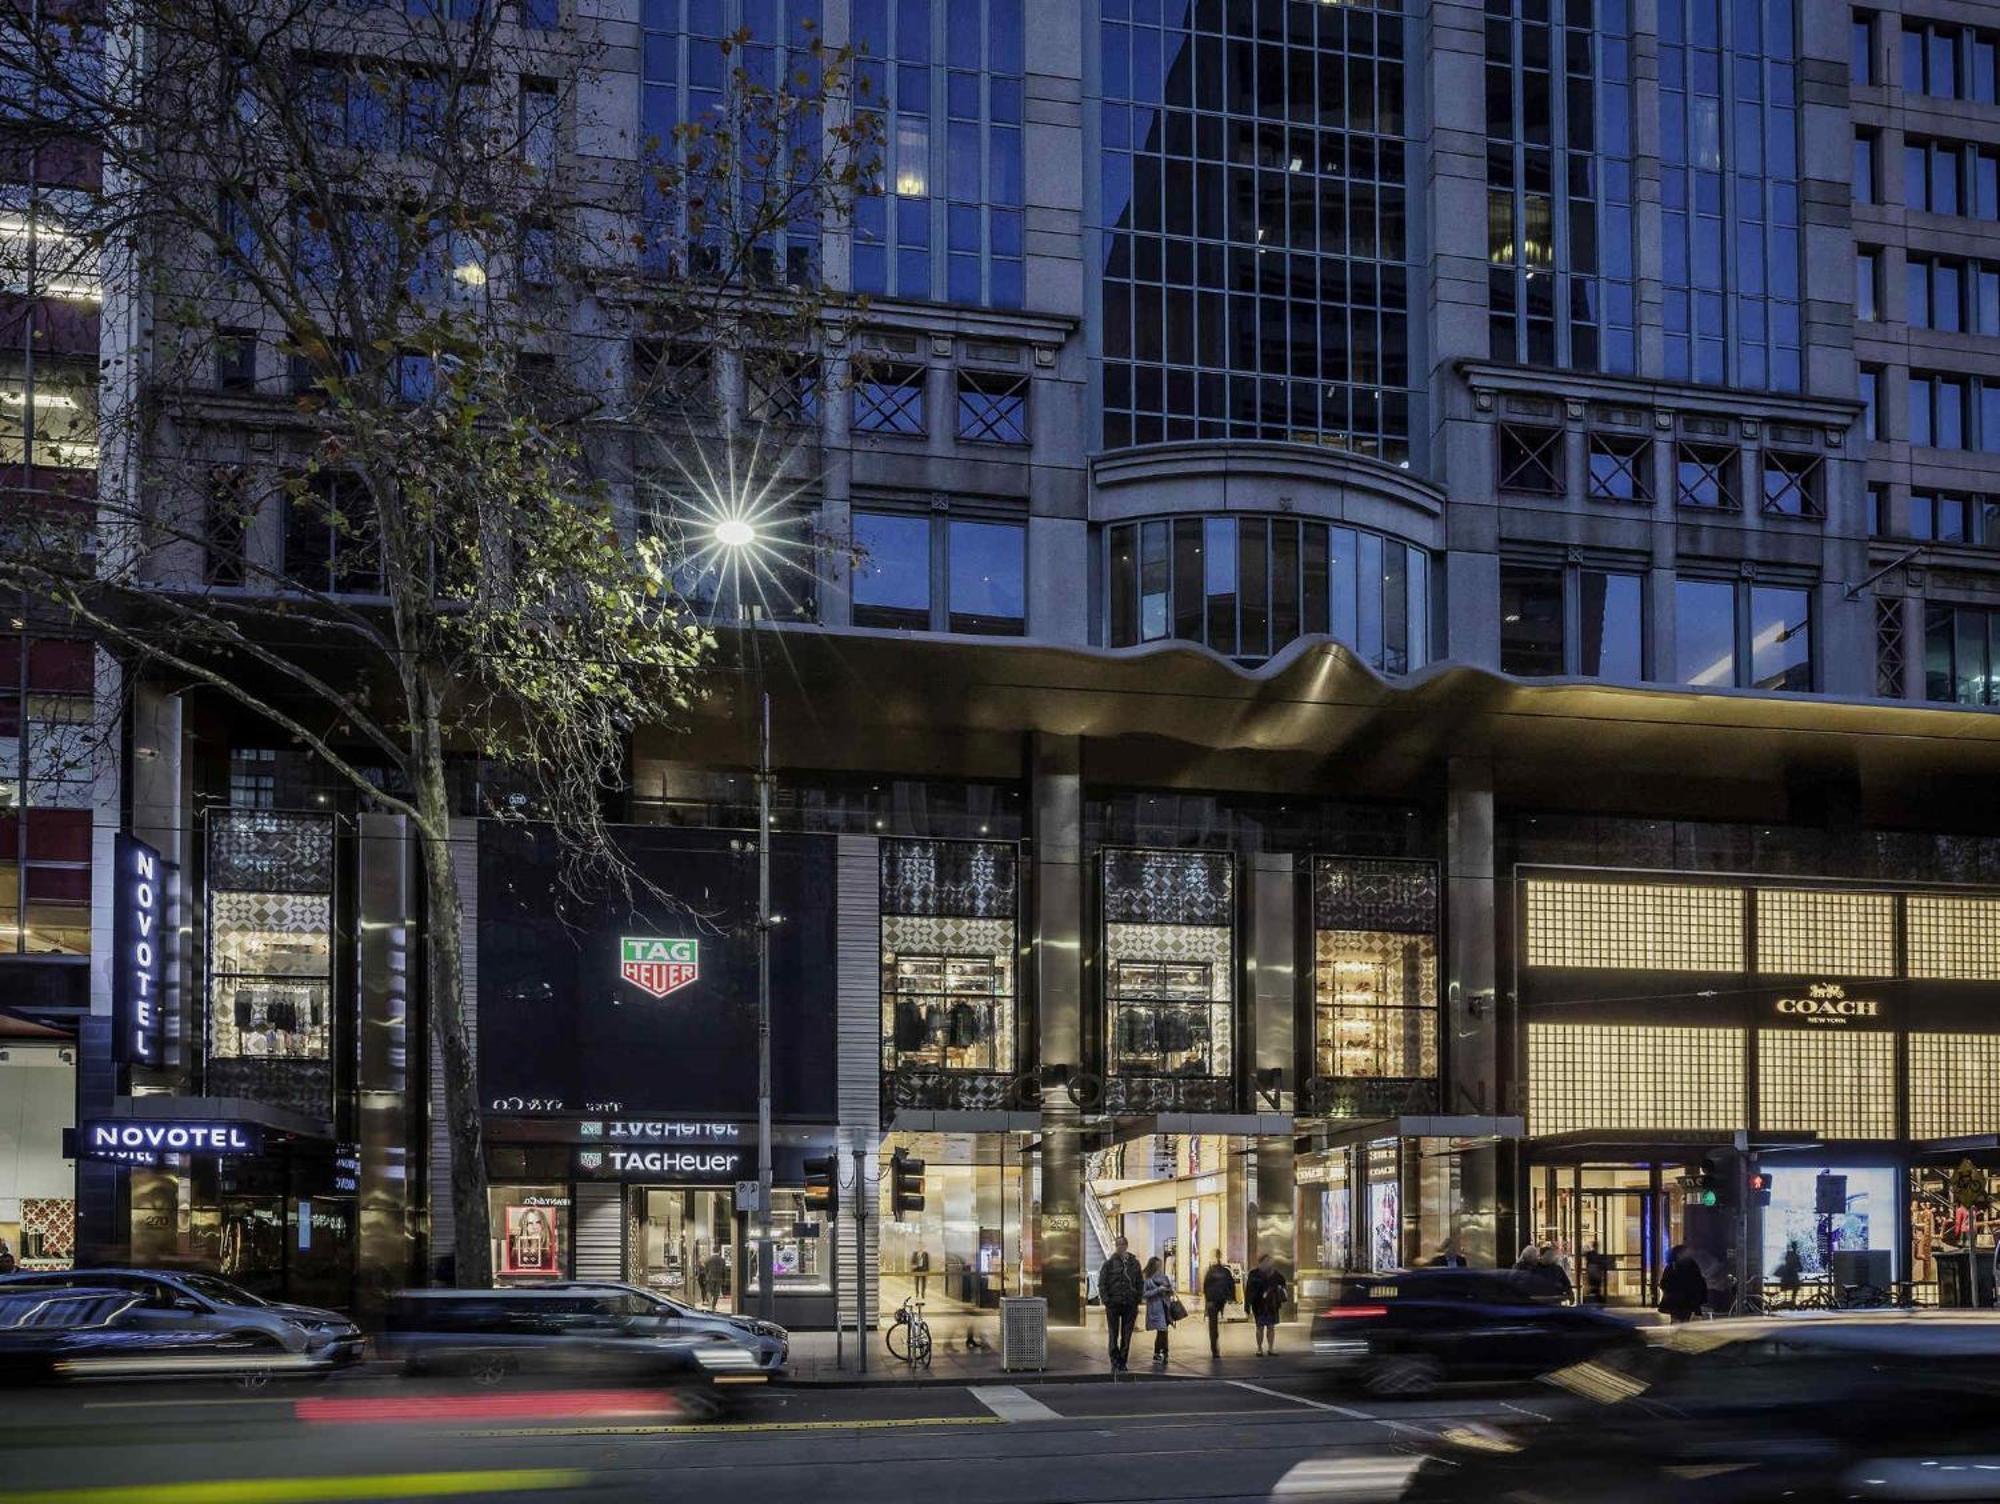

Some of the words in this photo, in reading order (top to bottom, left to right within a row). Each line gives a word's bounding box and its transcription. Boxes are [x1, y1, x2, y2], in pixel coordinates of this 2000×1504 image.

[137, 851, 153, 1055] NOVOTEL
[628, 941, 690, 960] TAG
[626, 964, 693, 992] HEUER
[1777, 1000, 1877, 1015] COACH
[96, 1127, 246, 1147] NOVOTEL
